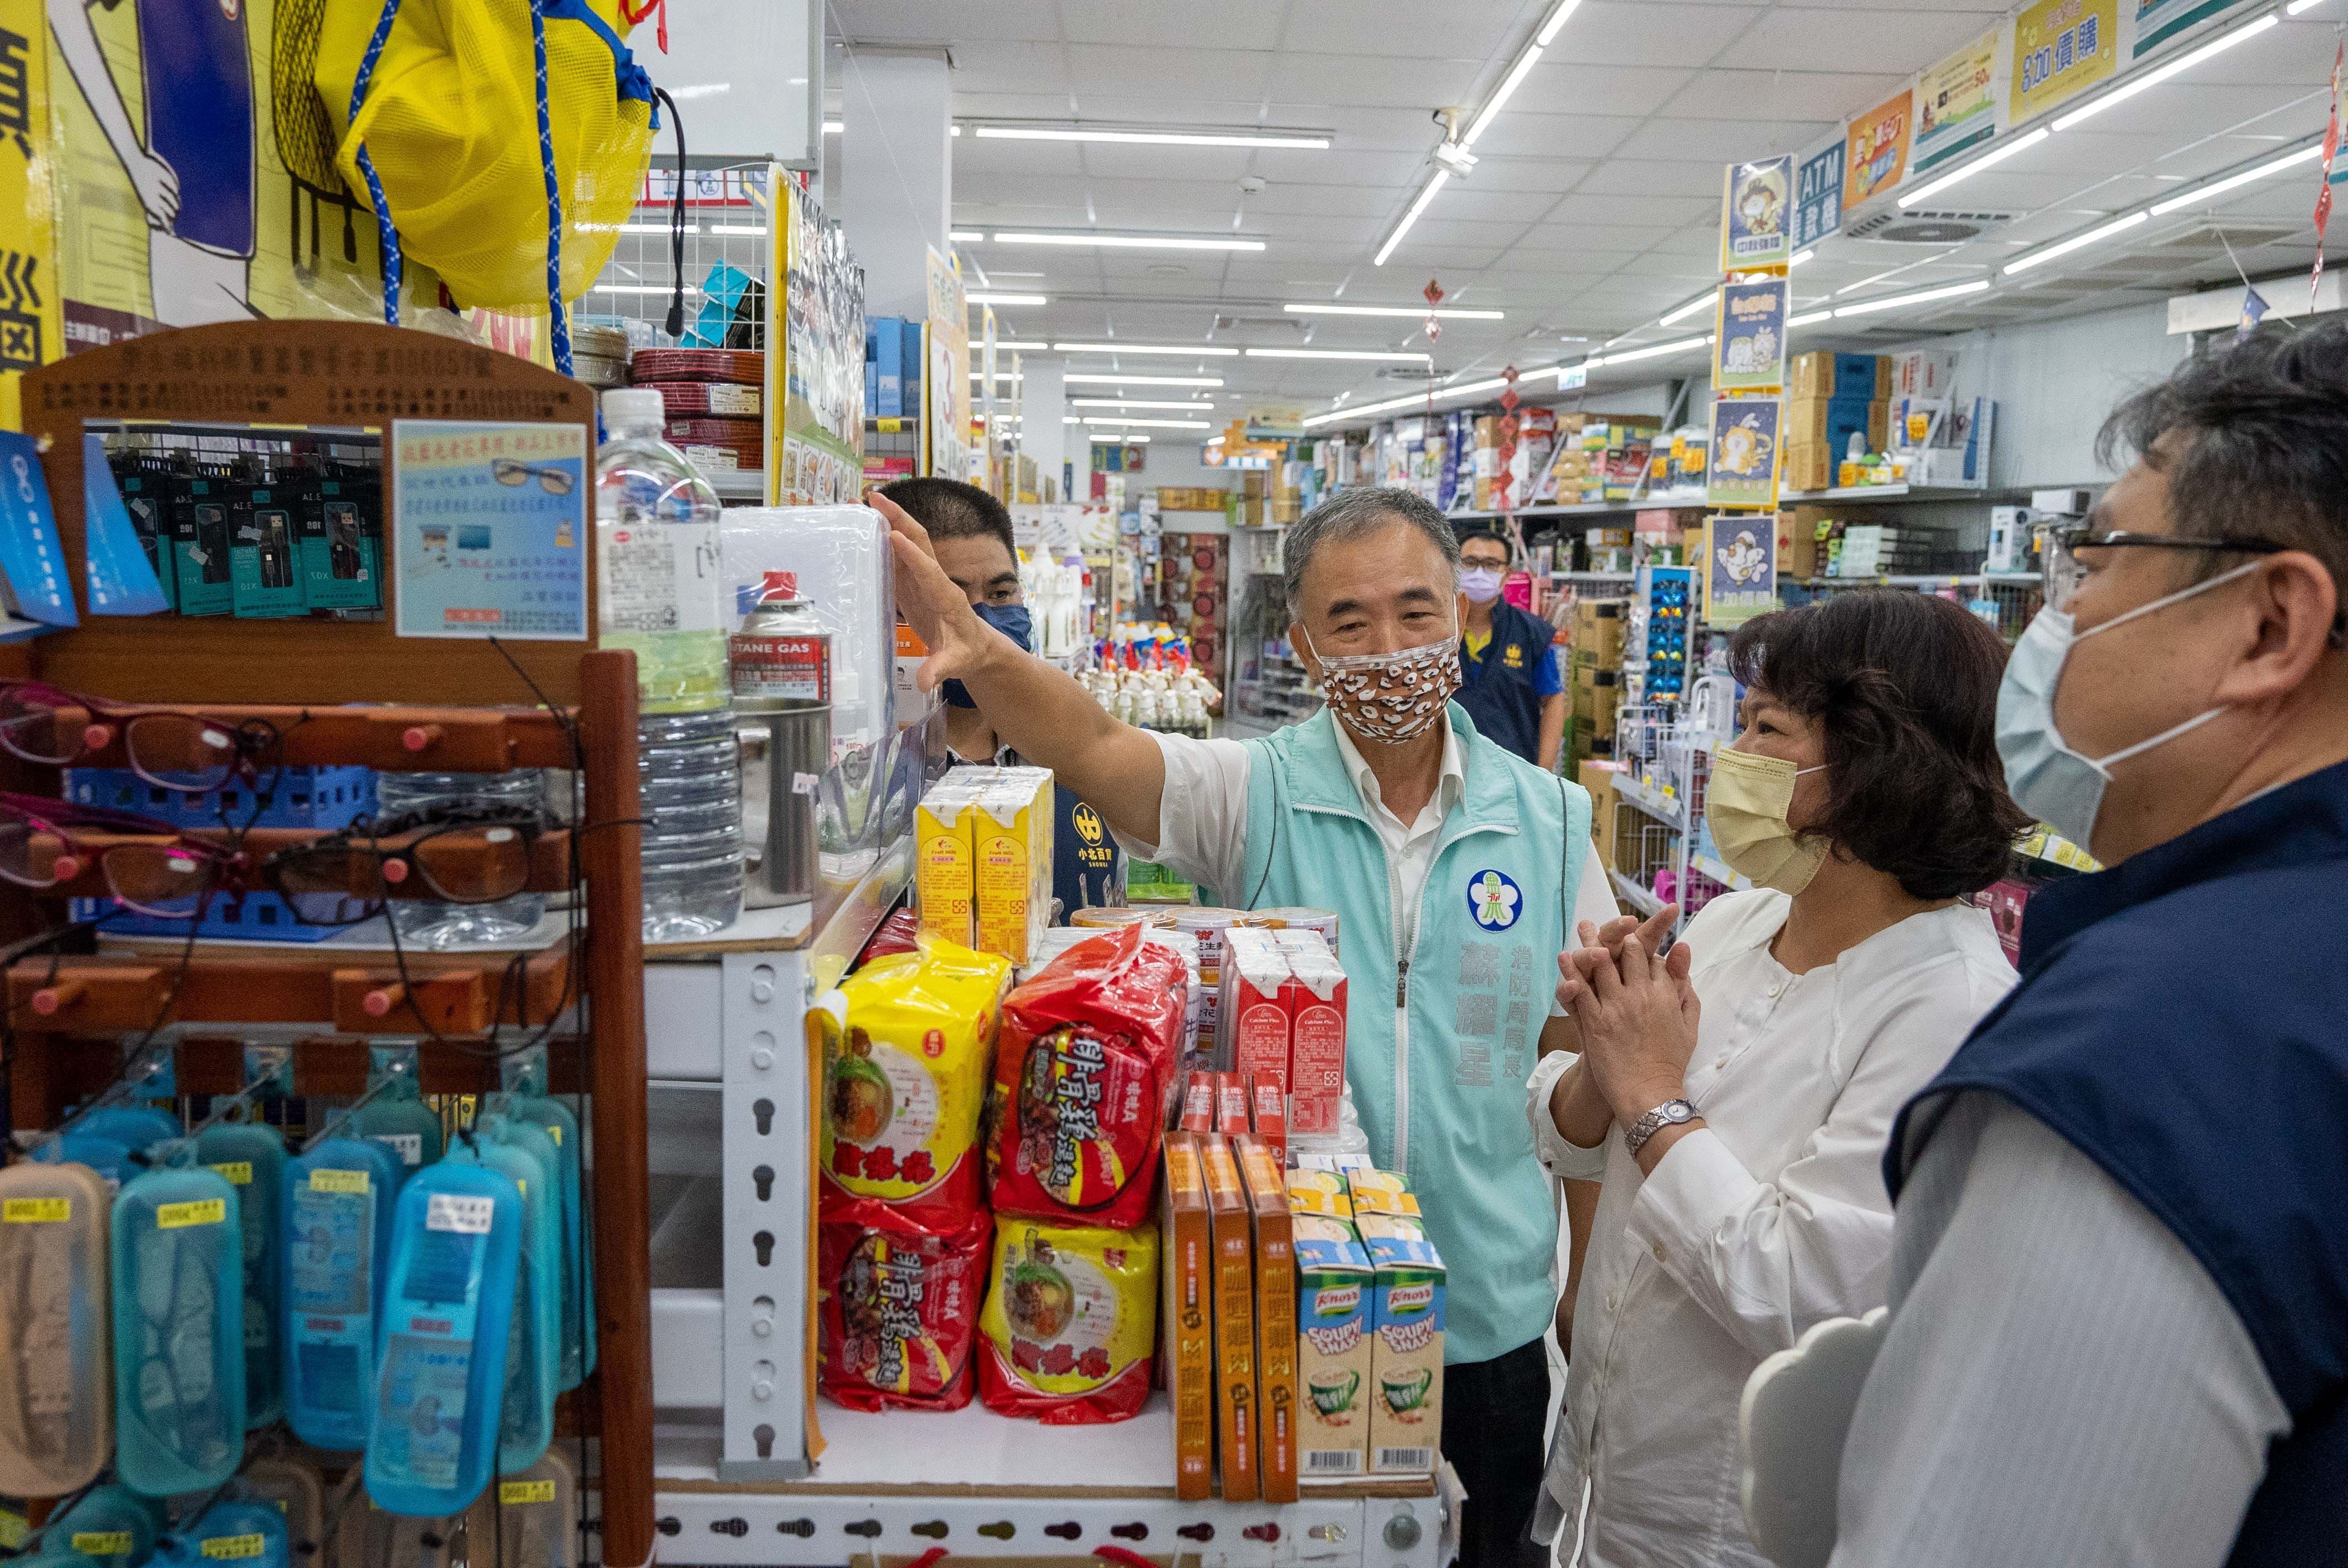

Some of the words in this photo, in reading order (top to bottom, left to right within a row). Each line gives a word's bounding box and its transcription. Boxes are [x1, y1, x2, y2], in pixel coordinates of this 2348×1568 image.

[2031, 12, 2098, 87] 加價購
[1801, 149, 1839, 201] ATM
[777, 643, 810, 653] GAS
[1078, 848, 1112, 860] 小北百貨
[1317, 1291, 1358, 1307] Knorr
[1391, 1289, 1430, 1303] Knorr
